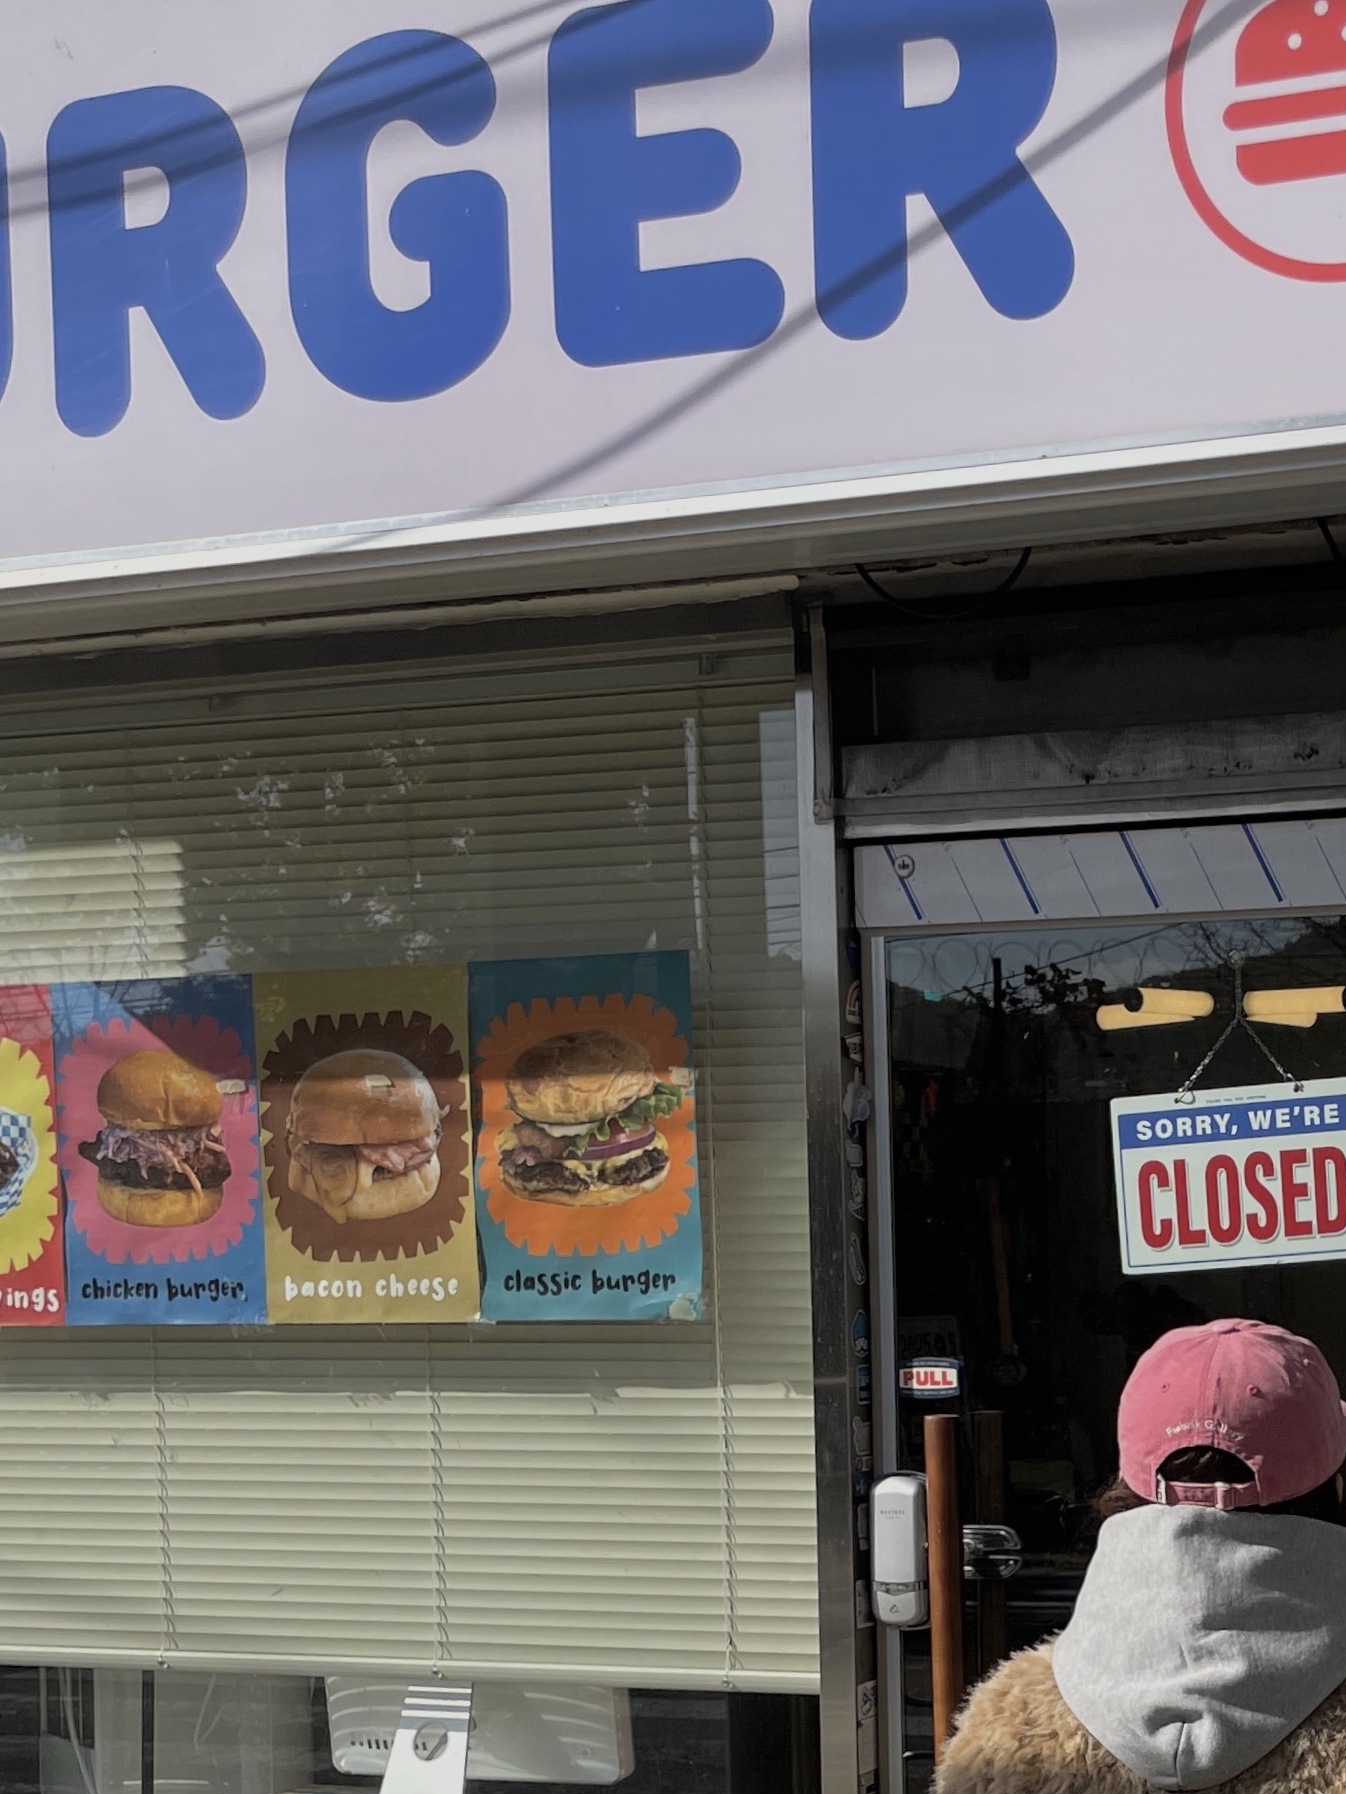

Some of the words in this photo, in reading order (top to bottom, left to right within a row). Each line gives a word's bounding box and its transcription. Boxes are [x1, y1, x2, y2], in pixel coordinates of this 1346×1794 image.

[0, 0, 1076, 438] RGER
[1136, 1112, 1238, 1141] SORRY,
[1247, 1103, 1340, 1130] WE'RE
[81, 1278, 158, 1300] chicken
[284, 1275, 362, 1301] bacon
[375, 1273, 459, 1301] cheese
[504, 1269, 582, 1296] classic
[591, 1268, 676, 1295] burger
[0, 1287, 60, 1312] ings
[903, 1371, 953, 1386] PULL
